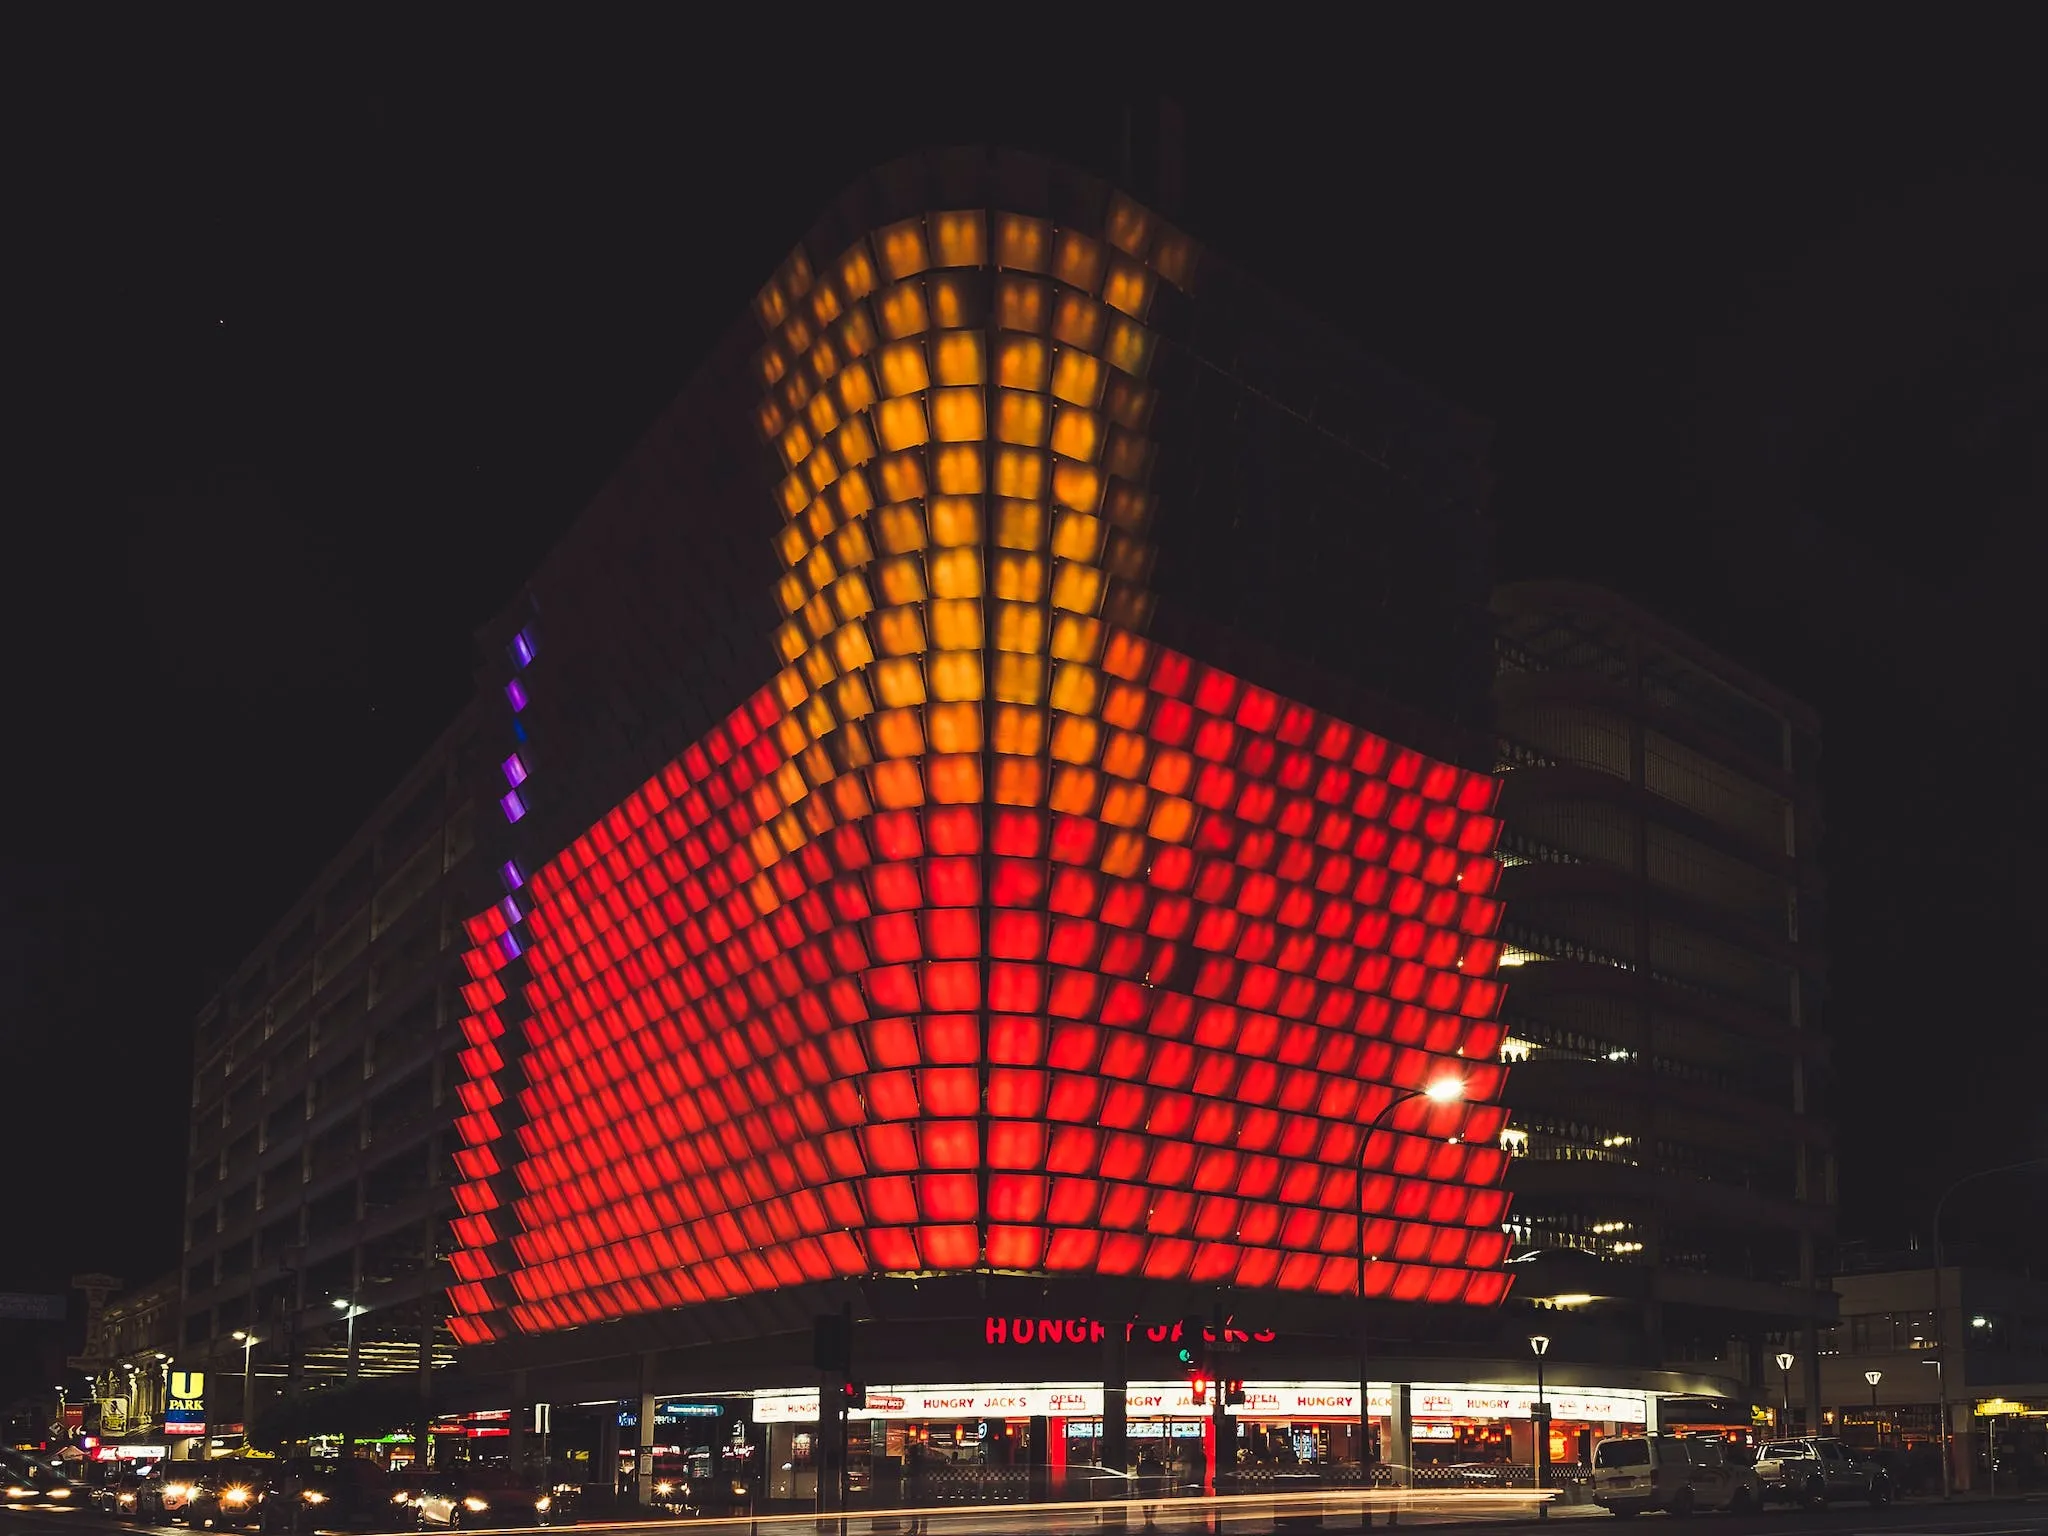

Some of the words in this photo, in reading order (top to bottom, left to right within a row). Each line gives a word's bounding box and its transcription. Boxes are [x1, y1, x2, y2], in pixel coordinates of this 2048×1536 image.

[171, 1371, 205, 1400] U
[923, 1398, 975, 1409] HUNGRY
[1050, 1394, 1084, 1404] OPEN
[1126, 1396, 1162, 1406] NGRY
[1244, 1394, 1277, 1403] OPEN
[1297, 1396, 1353, 1407] HUNGRY
[1366, 1397, 1392, 1407] ACK
[1467, 1399, 1510, 1409] HUNGRY
[168, 1399, 204, 1411] PARK
[787, 1403, 820, 1414] HUNGR
